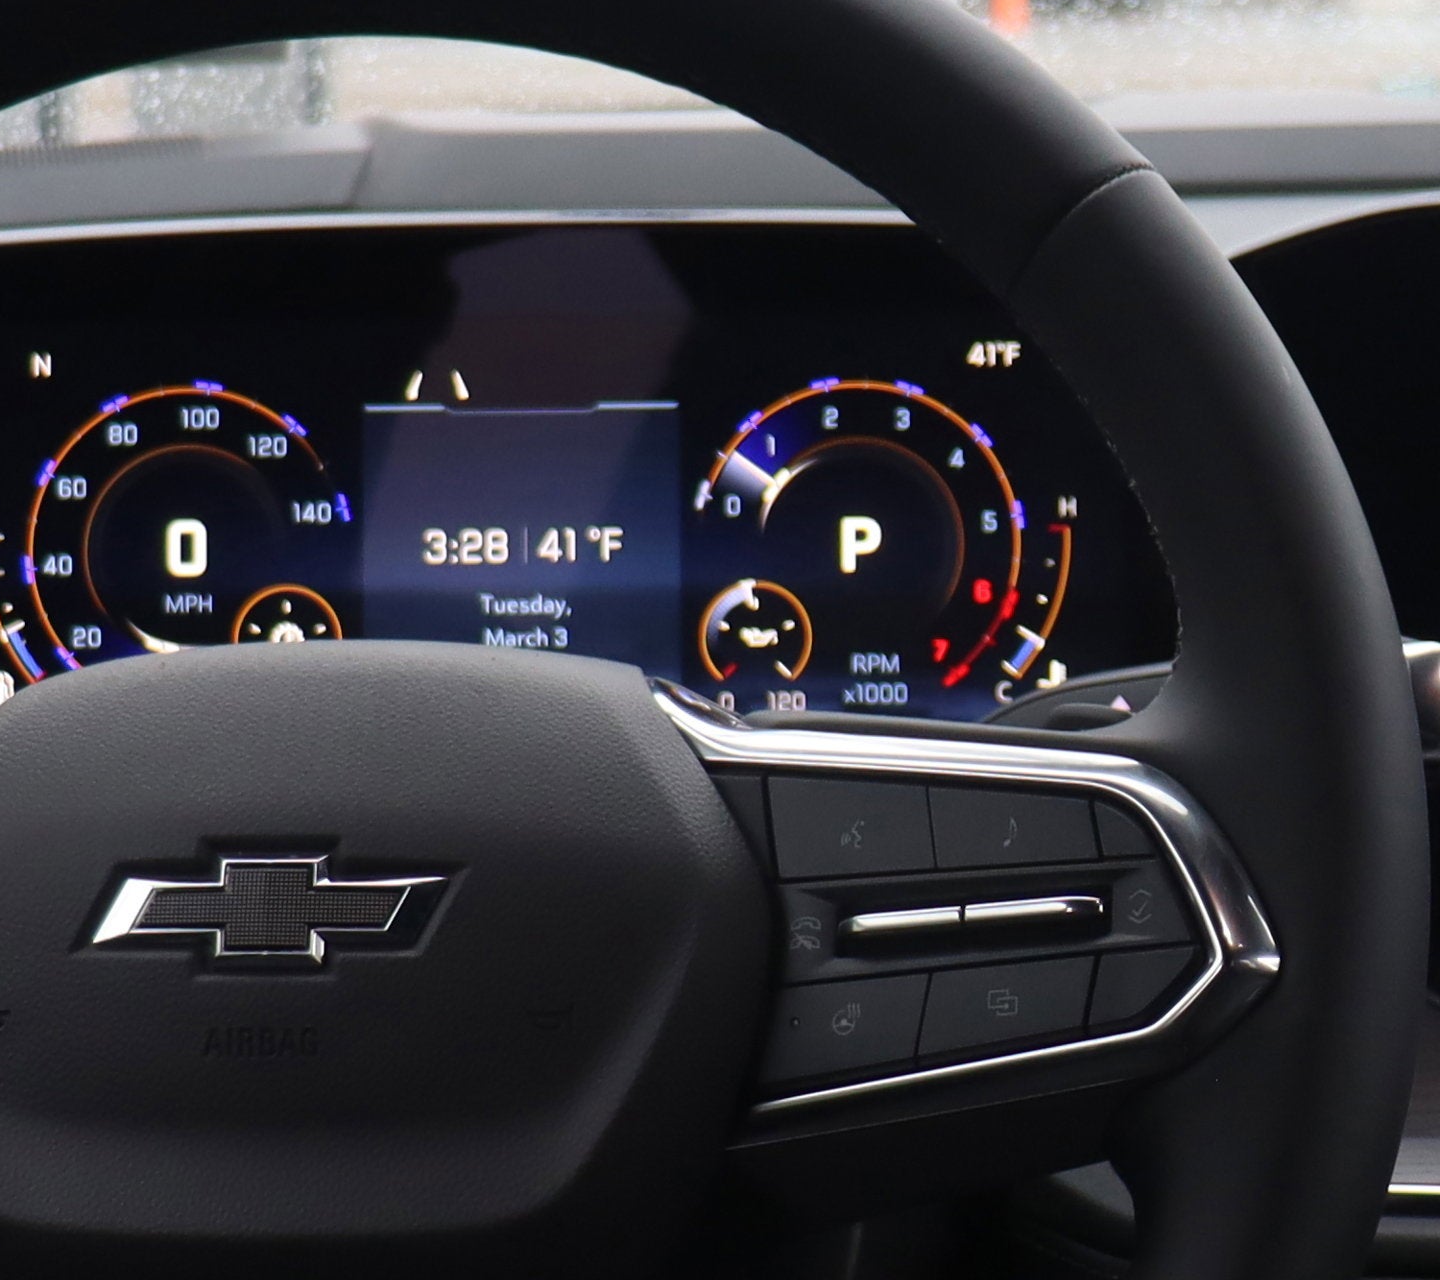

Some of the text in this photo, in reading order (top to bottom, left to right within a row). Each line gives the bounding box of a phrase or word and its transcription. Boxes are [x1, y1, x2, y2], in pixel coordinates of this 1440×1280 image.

[31, 352, 53, 379] N
[965, 341, 1022, 368] 41°F
[180, 408, 221, 430] 100
[822, 408, 839, 429] 2
[895, 408, 912, 429] 3
[108, 425, 139, 447] 80
[248, 436, 289, 458] 120
[948, 447, 966, 469] 4
[58, 478, 88, 500] 60
[293, 501, 333, 525] 140
[724, 495, 741, 517] 0
[1058, 495, 1078, 517] H
[981, 511, 998, 532] 5
[165, 518, 208, 578] 0
[422, 527, 509, 565] 3:28
[839, 516, 882, 573] P
[42, 554, 74, 576] 40
[973, 579, 992, 604] 6
[164, 594, 214, 614] MPH
[479, 593, 572, 618] Tuesday,
[72, 628, 102, 650] 20
[484, 627, 568, 648] March 3
[931, 638, 950, 663] 7
[851, 654, 900, 674] RPM
[768, 689, 806, 711] 120
[843, 681, 909, 704] x1000
[994, 681, 1013, 704] C
[203, 1028, 318, 1057] AIRBAG
